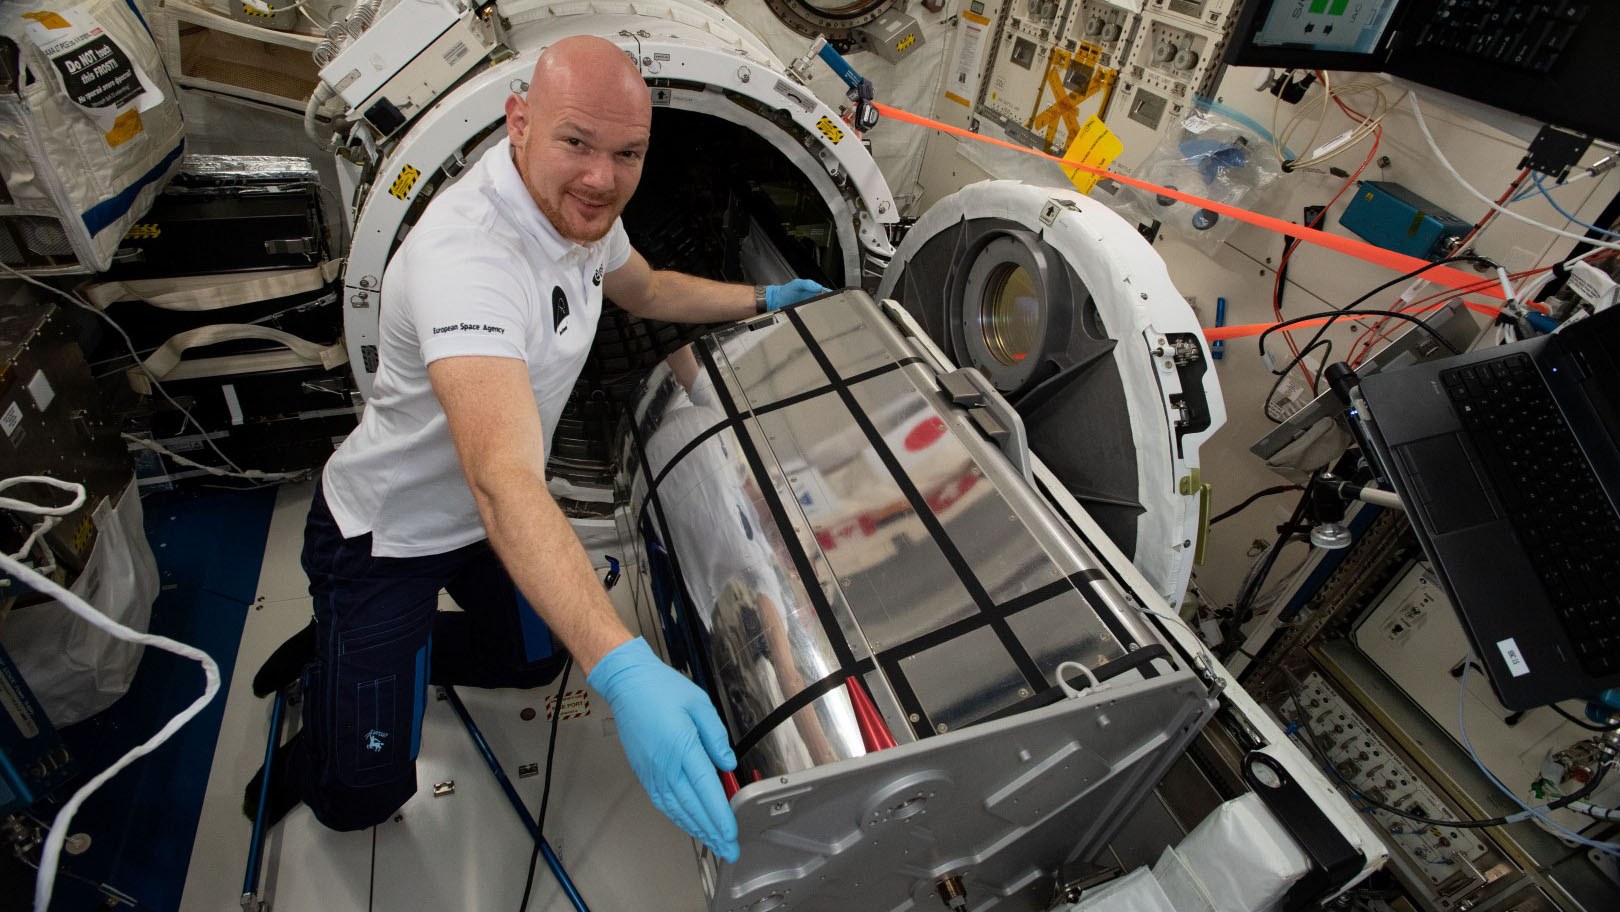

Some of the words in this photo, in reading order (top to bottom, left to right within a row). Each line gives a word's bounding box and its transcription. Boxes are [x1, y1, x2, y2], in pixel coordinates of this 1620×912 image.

[64, 59, 82, 73] Do
[78, 49, 97, 66] NOT
[95, 44, 113, 59] touch
[80, 70, 96, 84] this
[433, 325, 459, 334] European
[460, 323, 480, 332] Space
[483, 324, 505, 335] Agency
